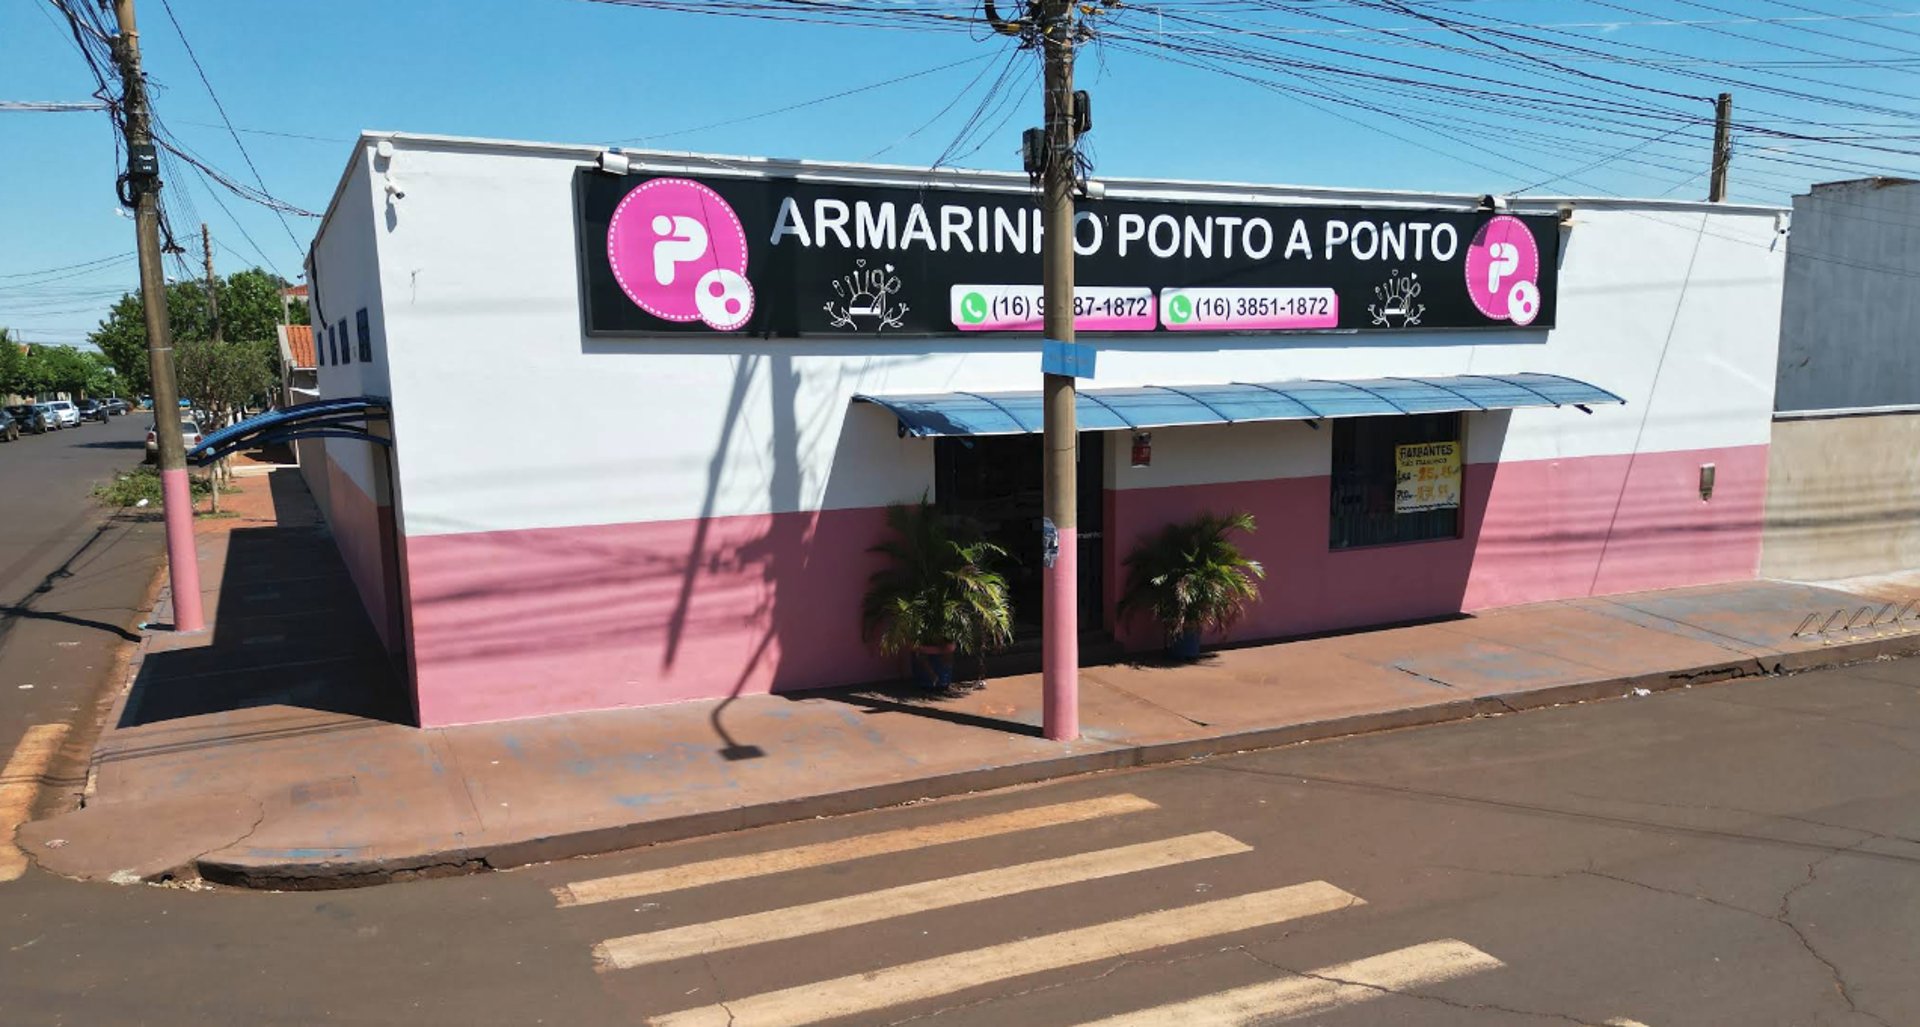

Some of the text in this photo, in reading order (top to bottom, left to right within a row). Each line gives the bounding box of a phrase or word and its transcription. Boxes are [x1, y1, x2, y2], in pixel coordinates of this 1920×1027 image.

[1118, 213, 1274, 260] PONTO
[1285, 218, 1314, 261] A
[1325, 219, 1459, 263] PONTO
[992, 296, 1147, 321] (16) 987-1872
[1195, 297, 1328, 321] (16) 3851-1872
